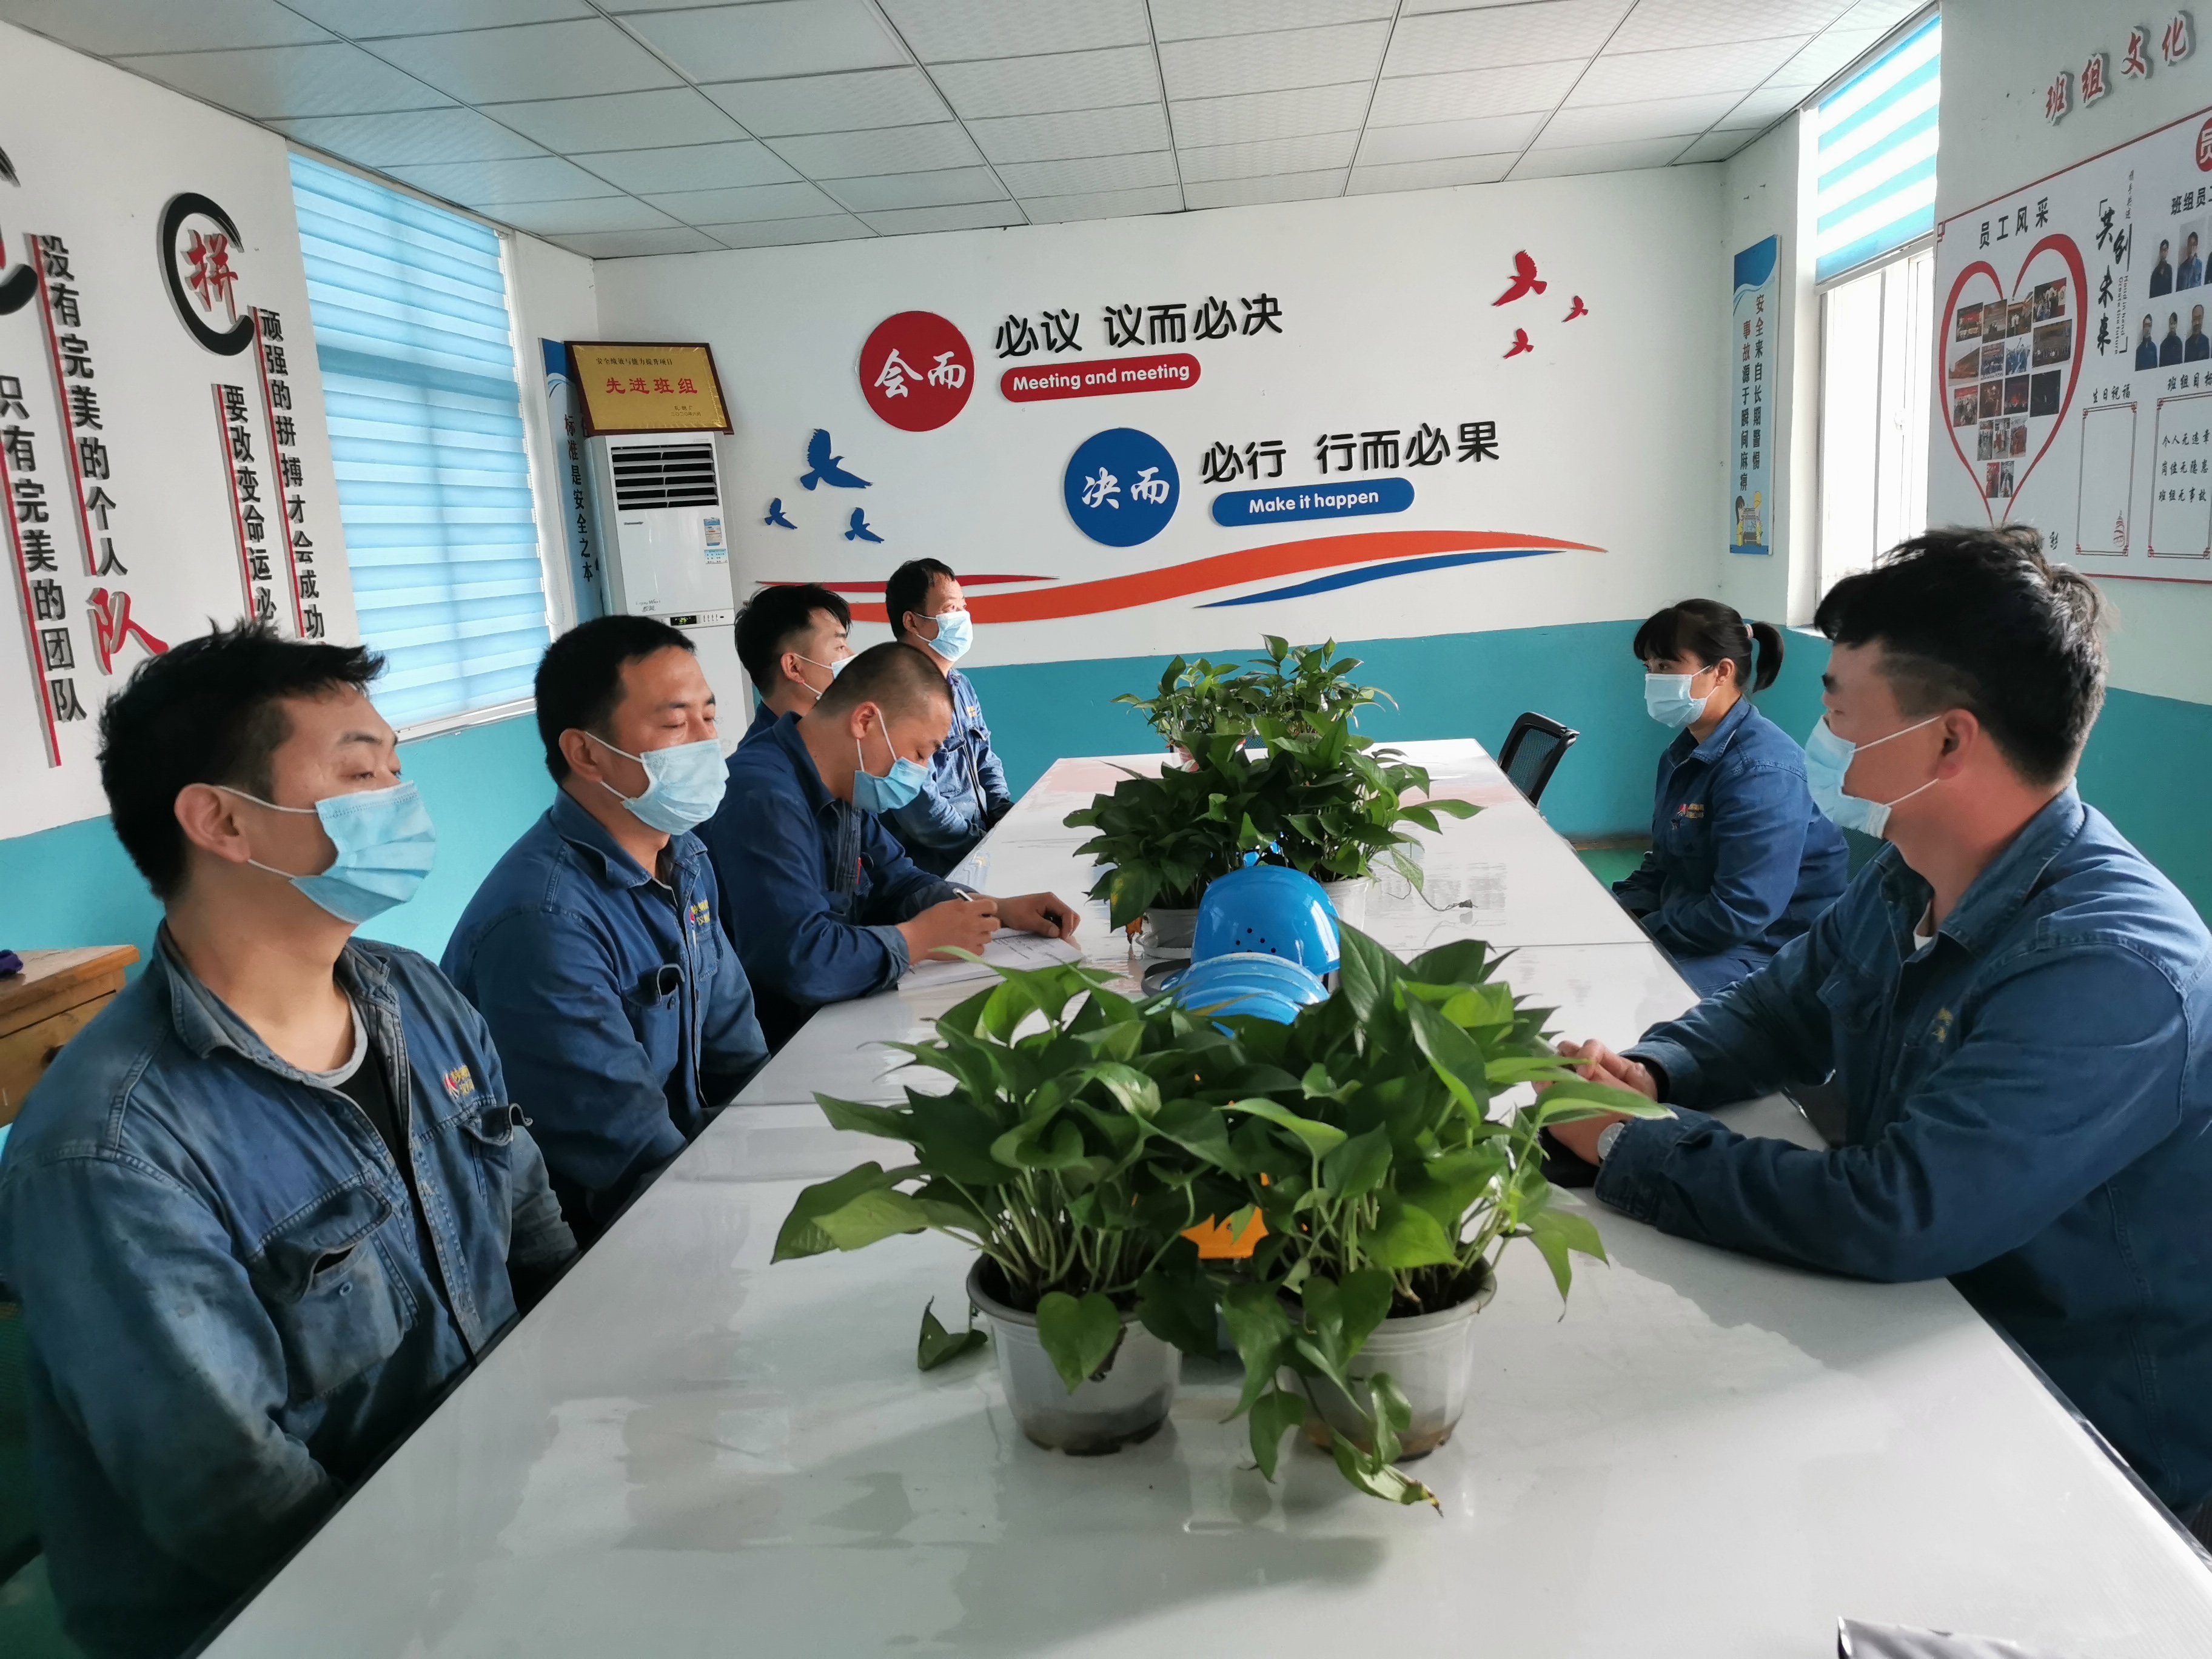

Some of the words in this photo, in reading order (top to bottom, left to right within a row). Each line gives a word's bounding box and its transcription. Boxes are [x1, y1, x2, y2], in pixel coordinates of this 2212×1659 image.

[2045, 15, 2189, 122] 班组文化
[1979, 197, 2048, 249] 员工风采
[180, 229, 239, 324] 拼
[606, 377, 697, 394] 先进班组
[874, 349, 967, 398] 会而
[994, 308, 1084, 359] 必议
[1103, 293, 1284, 349] 议而必决
[1013, 372, 1081, 390] Meeting
[1085, 368, 1116, 384] and
[1121, 364, 1190, 381] meeting
[1752, 294, 1765, 471] 安全来自长期警惕
[40, 235, 128, 575] 没有完美的个人
[2093, 383, 2131, 403] 生日祝福
[2162, 429, 2210, 448] 个人无违章
[223, 384, 277, 620] 要改变命运必
[260, 308, 325, 639] 顽强的拼搏才会成功
[565, 414, 593, 582] 标准是安全之本
[1081, 466, 1170, 511] 决而
[1201, 440, 1287, 484] 必行
[1316, 421, 1499, 476] 行而必果
[1249, 497, 1296, 514] Make
[1299, 495, 1311, 509] it
[1315, 492, 1379, 509] happen
[2158, 486, 2207, 503] 班组无事故
[0, 375, 87, 722] 只有完美的团队
[86, 587, 169, 675] 队
